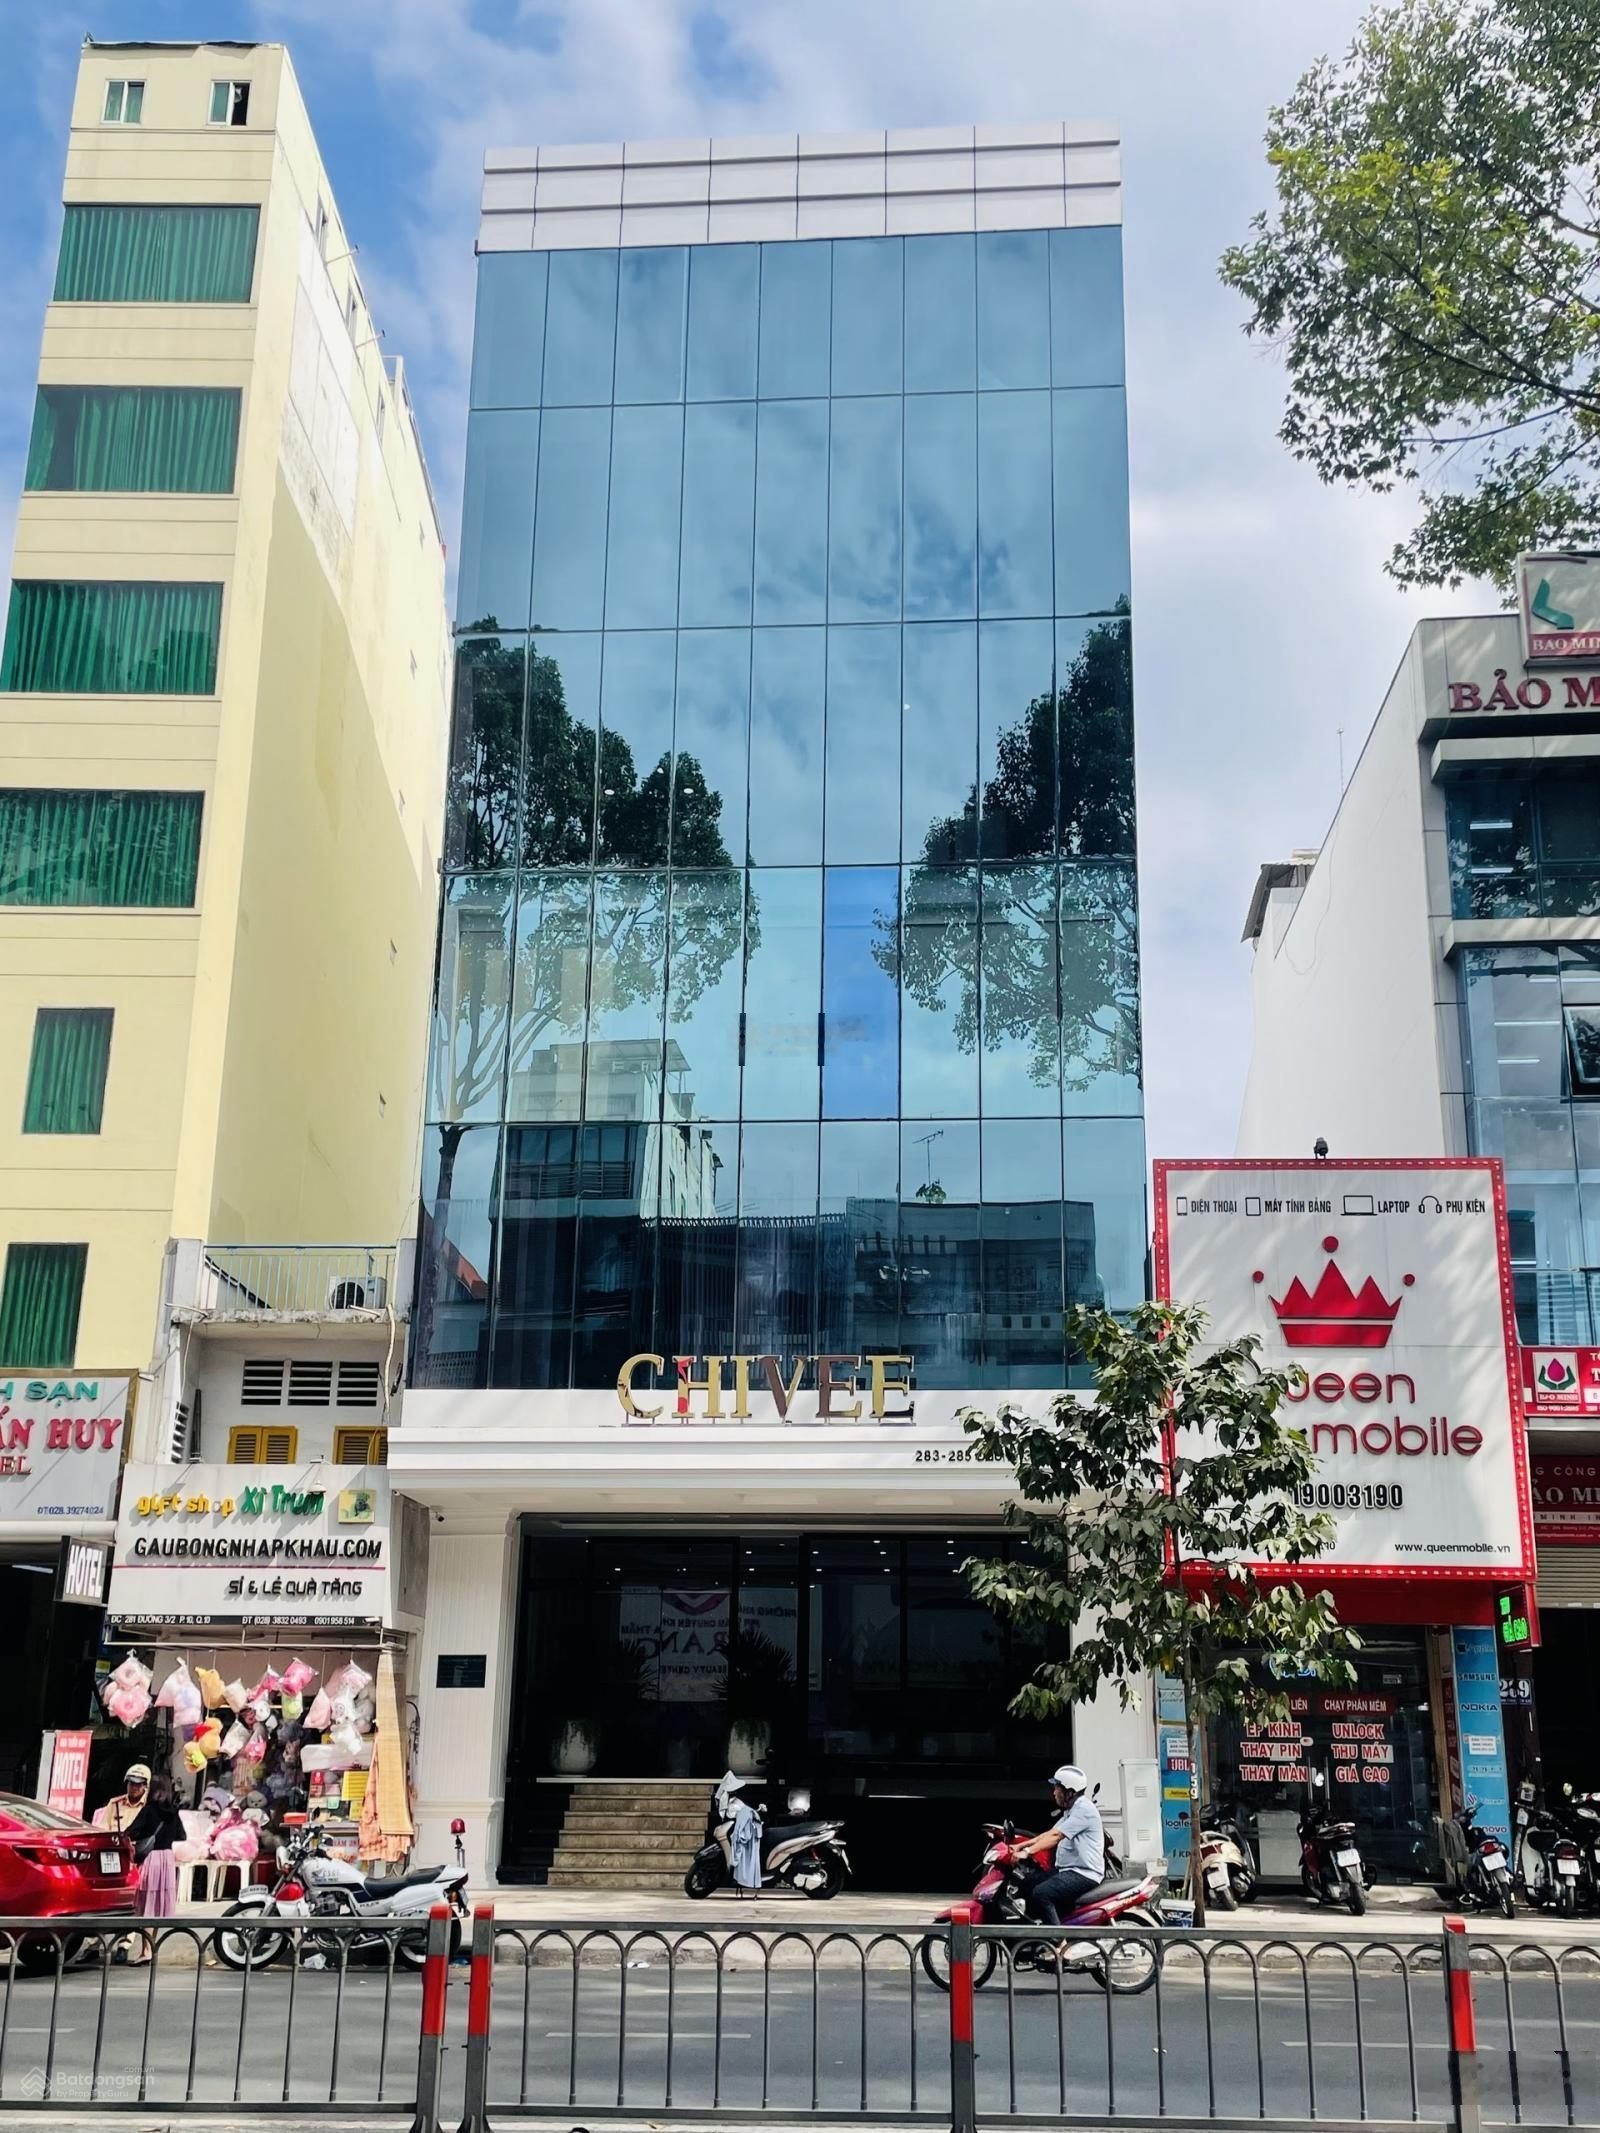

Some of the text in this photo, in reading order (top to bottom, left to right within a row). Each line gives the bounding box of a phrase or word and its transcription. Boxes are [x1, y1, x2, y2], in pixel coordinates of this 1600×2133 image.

[1449, 668, 1551, 713] BẢO
[1264, 1198, 1283, 1213] MÁY
[1286, 1198, 1305, 1213] TÍNH
[1378, 1200, 1410, 1213] LAPTOP
[1446, 1198, 1486, 1216] PHỤ KIỆN
[25, 1381, 99, 1408] SẠN
[617, 1353, 915, 1420] CHIVEE
[1286, 1372, 1416, 1404] ueen
[46, 1418, 122, 1450] HUY
[1312, 1416, 1483, 1457] mobile
[1553, 1465, 1597, 1476] CÔNG
[136, 1493, 182, 1517] gift
[186, 1494, 237, 1518] shop
[134, 1537, 383, 1559] GAUBONGNHAPKHAU.COM
[1394, 1541, 1511, 1553] www.queenmobile.vn
[65, 1544, 104, 1598] HOTEL
[248, 1580, 258, 1594] &
[285, 1577, 317, 1596] QUÀ
[165, 1615, 176, 1624] 3/2
[1461, 1703, 1498, 1712] NOKIA
[1332, 1723, 1385, 1739] UNLOCK
[1240, 1741, 1389, 1759] THAY PIN THU MÁY
[51, 1752, 85, 1790] HOTEL
[1239, 1762, 1390, 1783] THAY MÀN GIÁ CAO
[1165, 1818, 1192, 1830] logite
